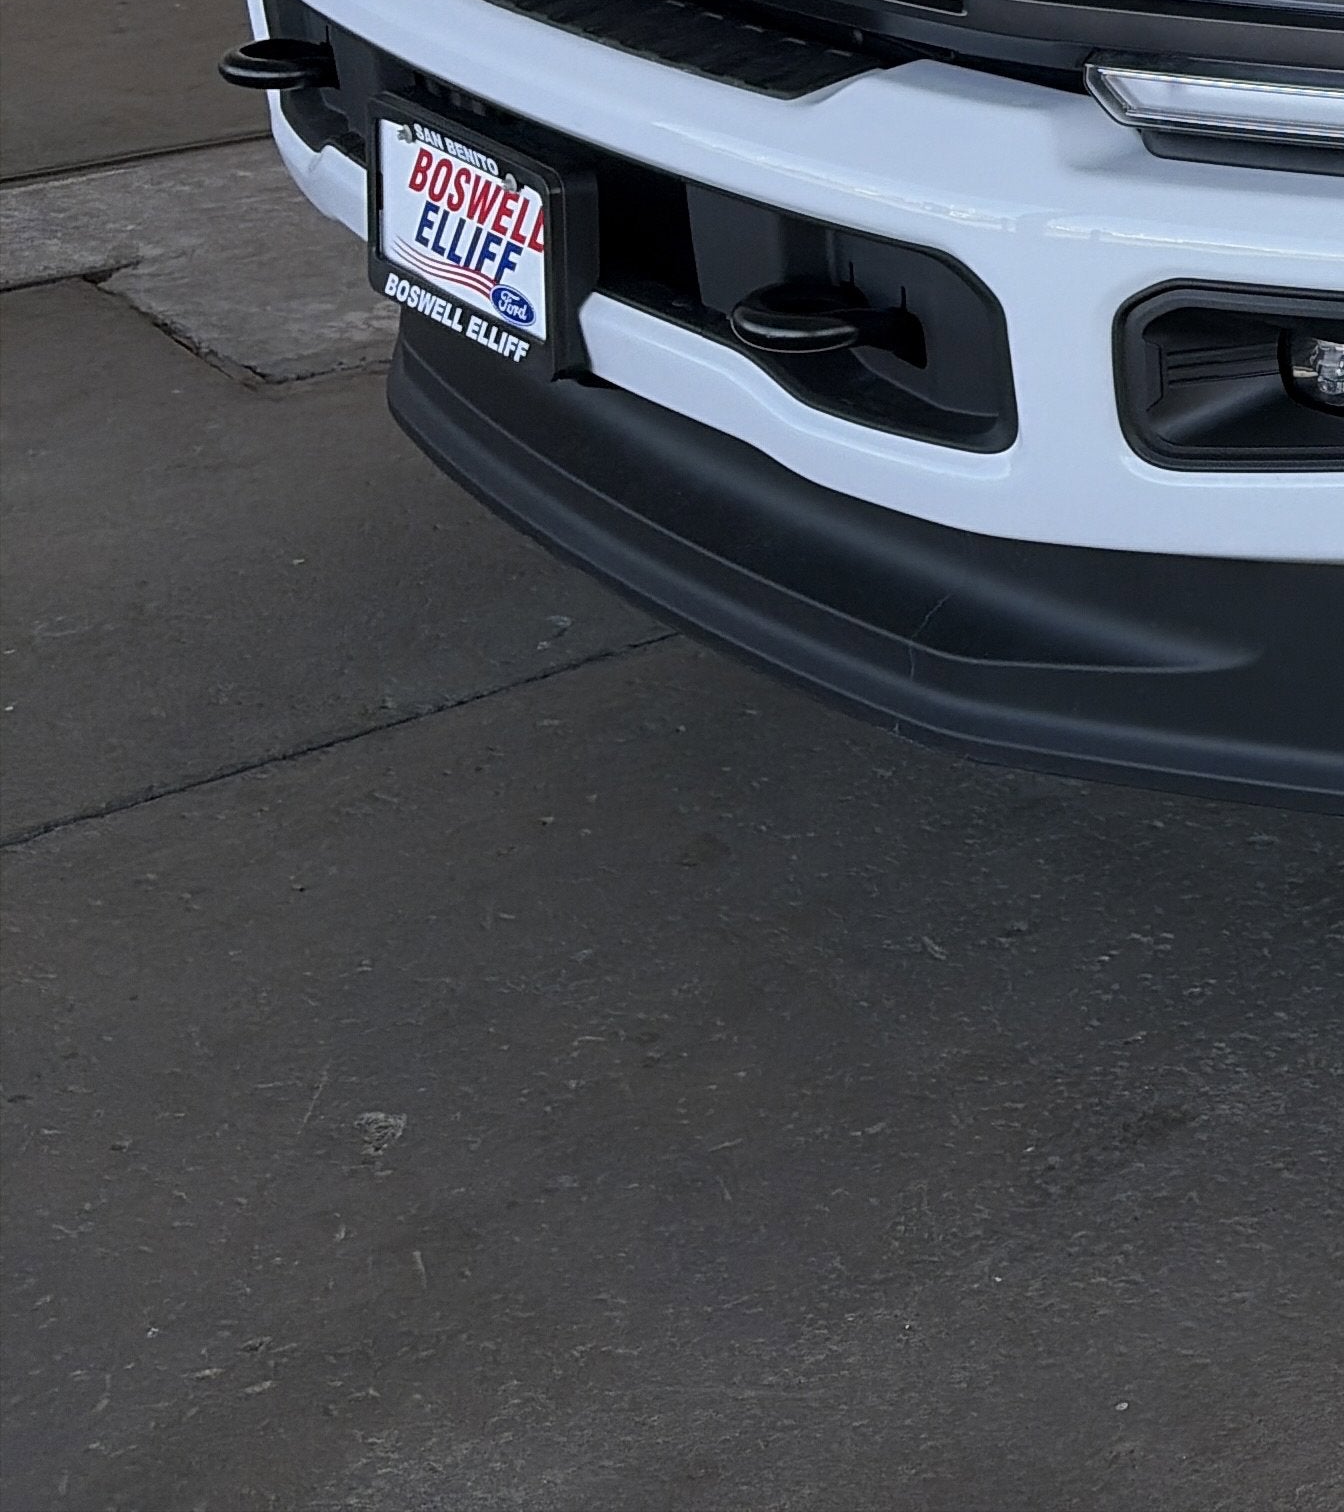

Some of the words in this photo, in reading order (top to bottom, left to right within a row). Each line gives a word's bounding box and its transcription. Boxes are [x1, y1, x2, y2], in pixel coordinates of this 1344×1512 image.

[413, 123, 444, 151] SAN
[447, 138, 499, 176] BENITO
[408, 147, 545, 253] BOSWELL
[415, 200, 524, 284] ELLIFF
[384, 272, 464, 333] BOSWELL
[465, 315, 530, 363] ELLIFF
[498, 289, 529, 321] Ford
